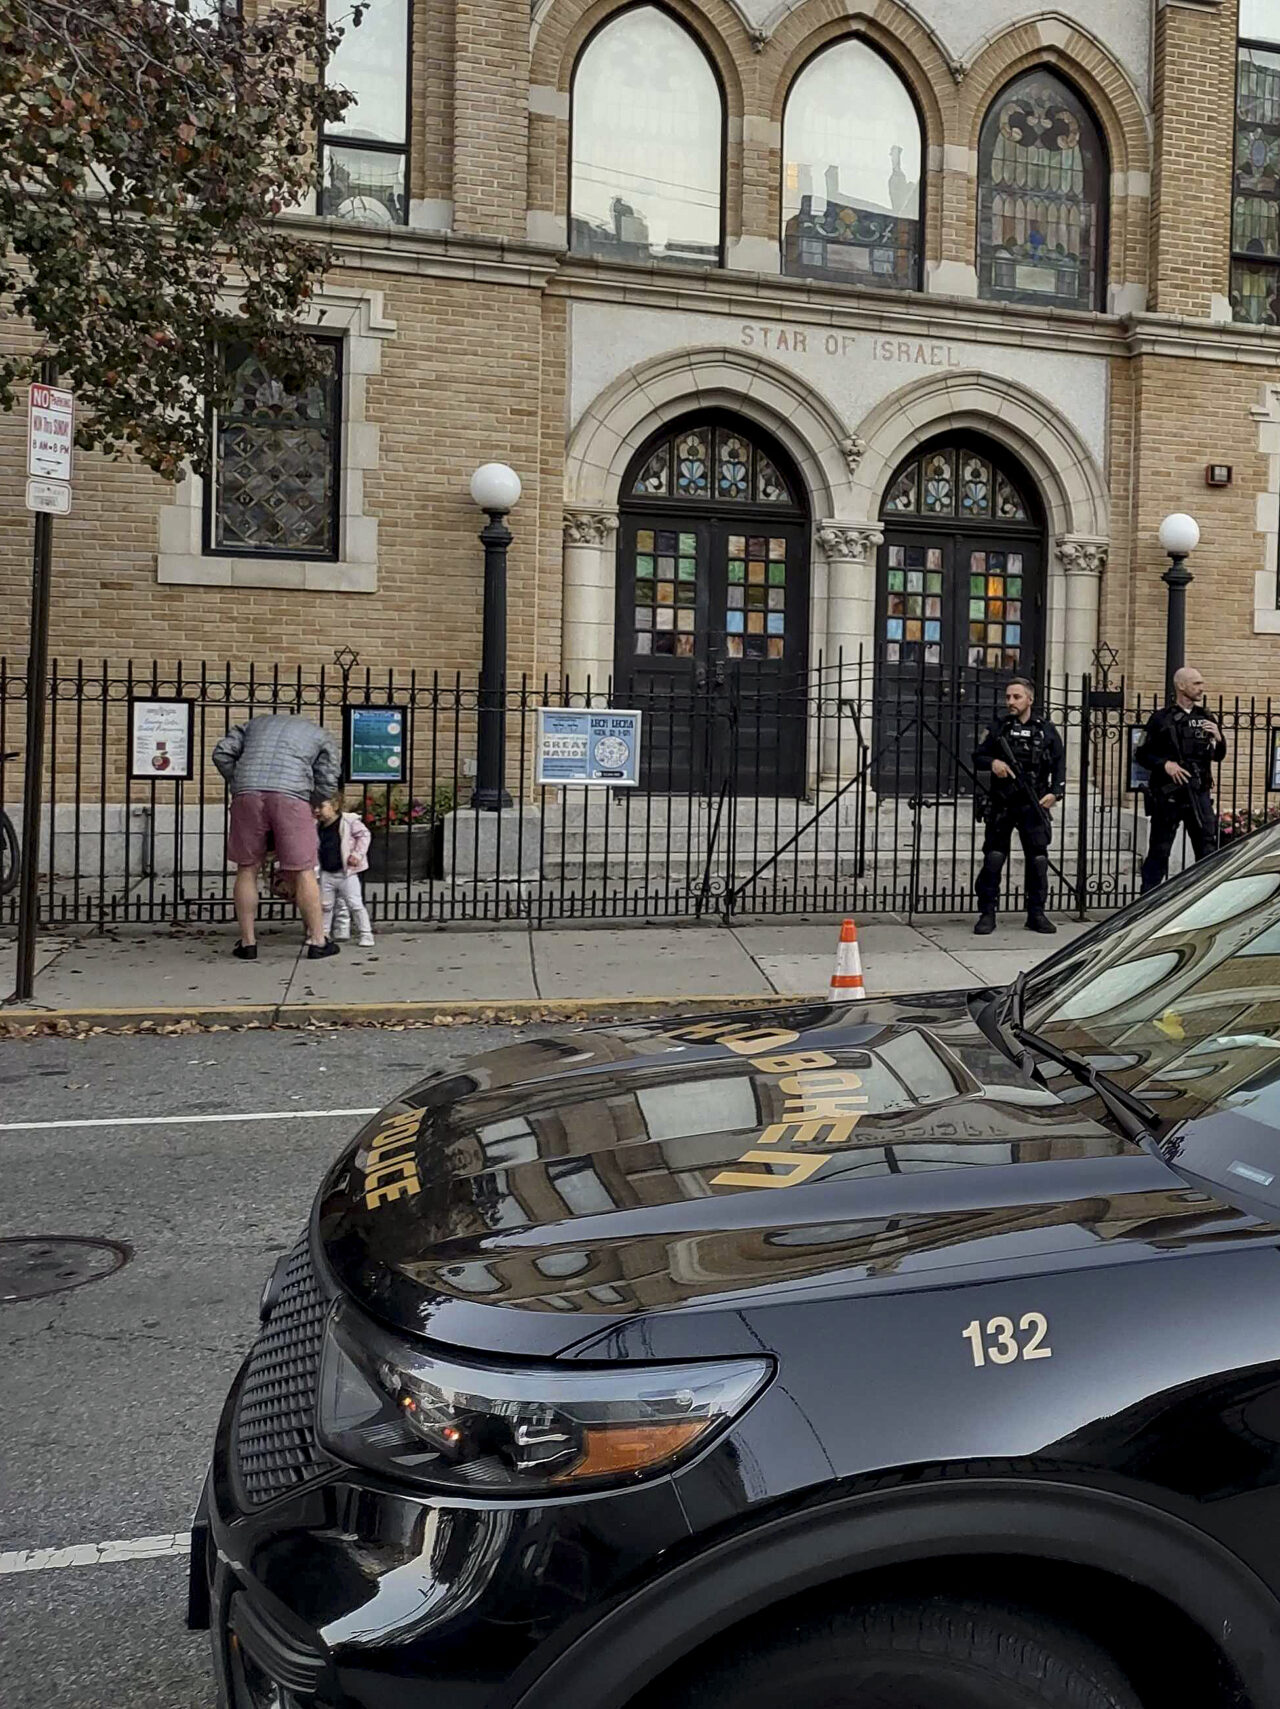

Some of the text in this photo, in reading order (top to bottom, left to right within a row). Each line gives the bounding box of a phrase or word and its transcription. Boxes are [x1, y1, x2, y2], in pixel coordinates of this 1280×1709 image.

[741, 325, 961, 367] STAR OF ISRAEL
[33, 388, 49, 407] NO
[543, 740, 588, 749] GREAT
[656, 1021, 869, 1188] HOBOKEN
[365, 1106, 428, 1210] POLICE
[962, 1312, 1052, 1367] 132
